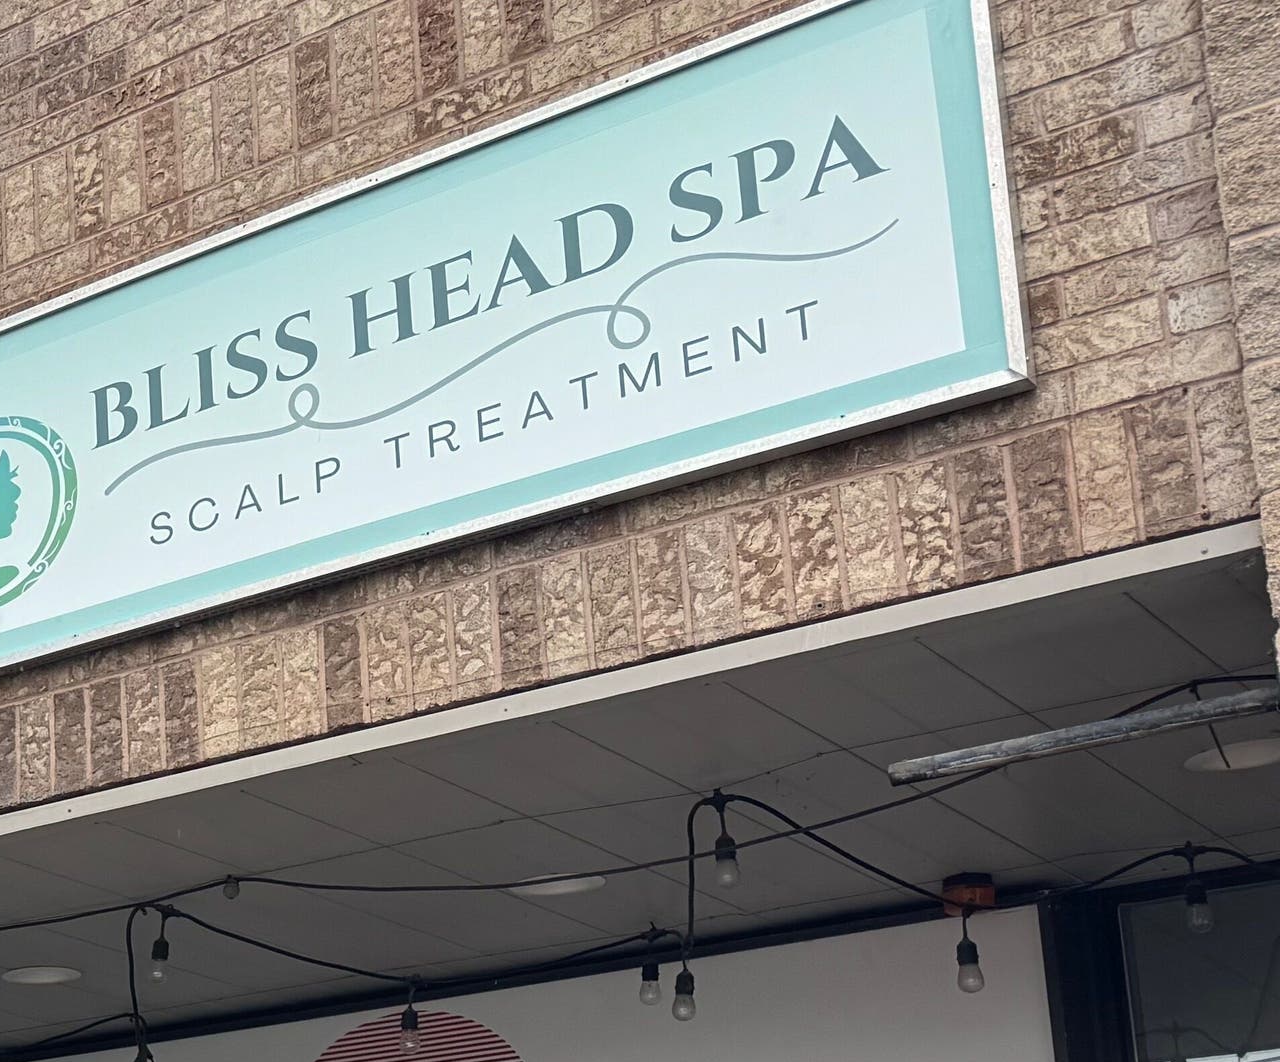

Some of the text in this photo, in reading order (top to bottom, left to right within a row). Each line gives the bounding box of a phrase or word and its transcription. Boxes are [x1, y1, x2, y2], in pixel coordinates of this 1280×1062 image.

[89, 113, 888, 451] BLISS HEAD SPA
[149, 299, 821, 546] SCALP TREATMENT
